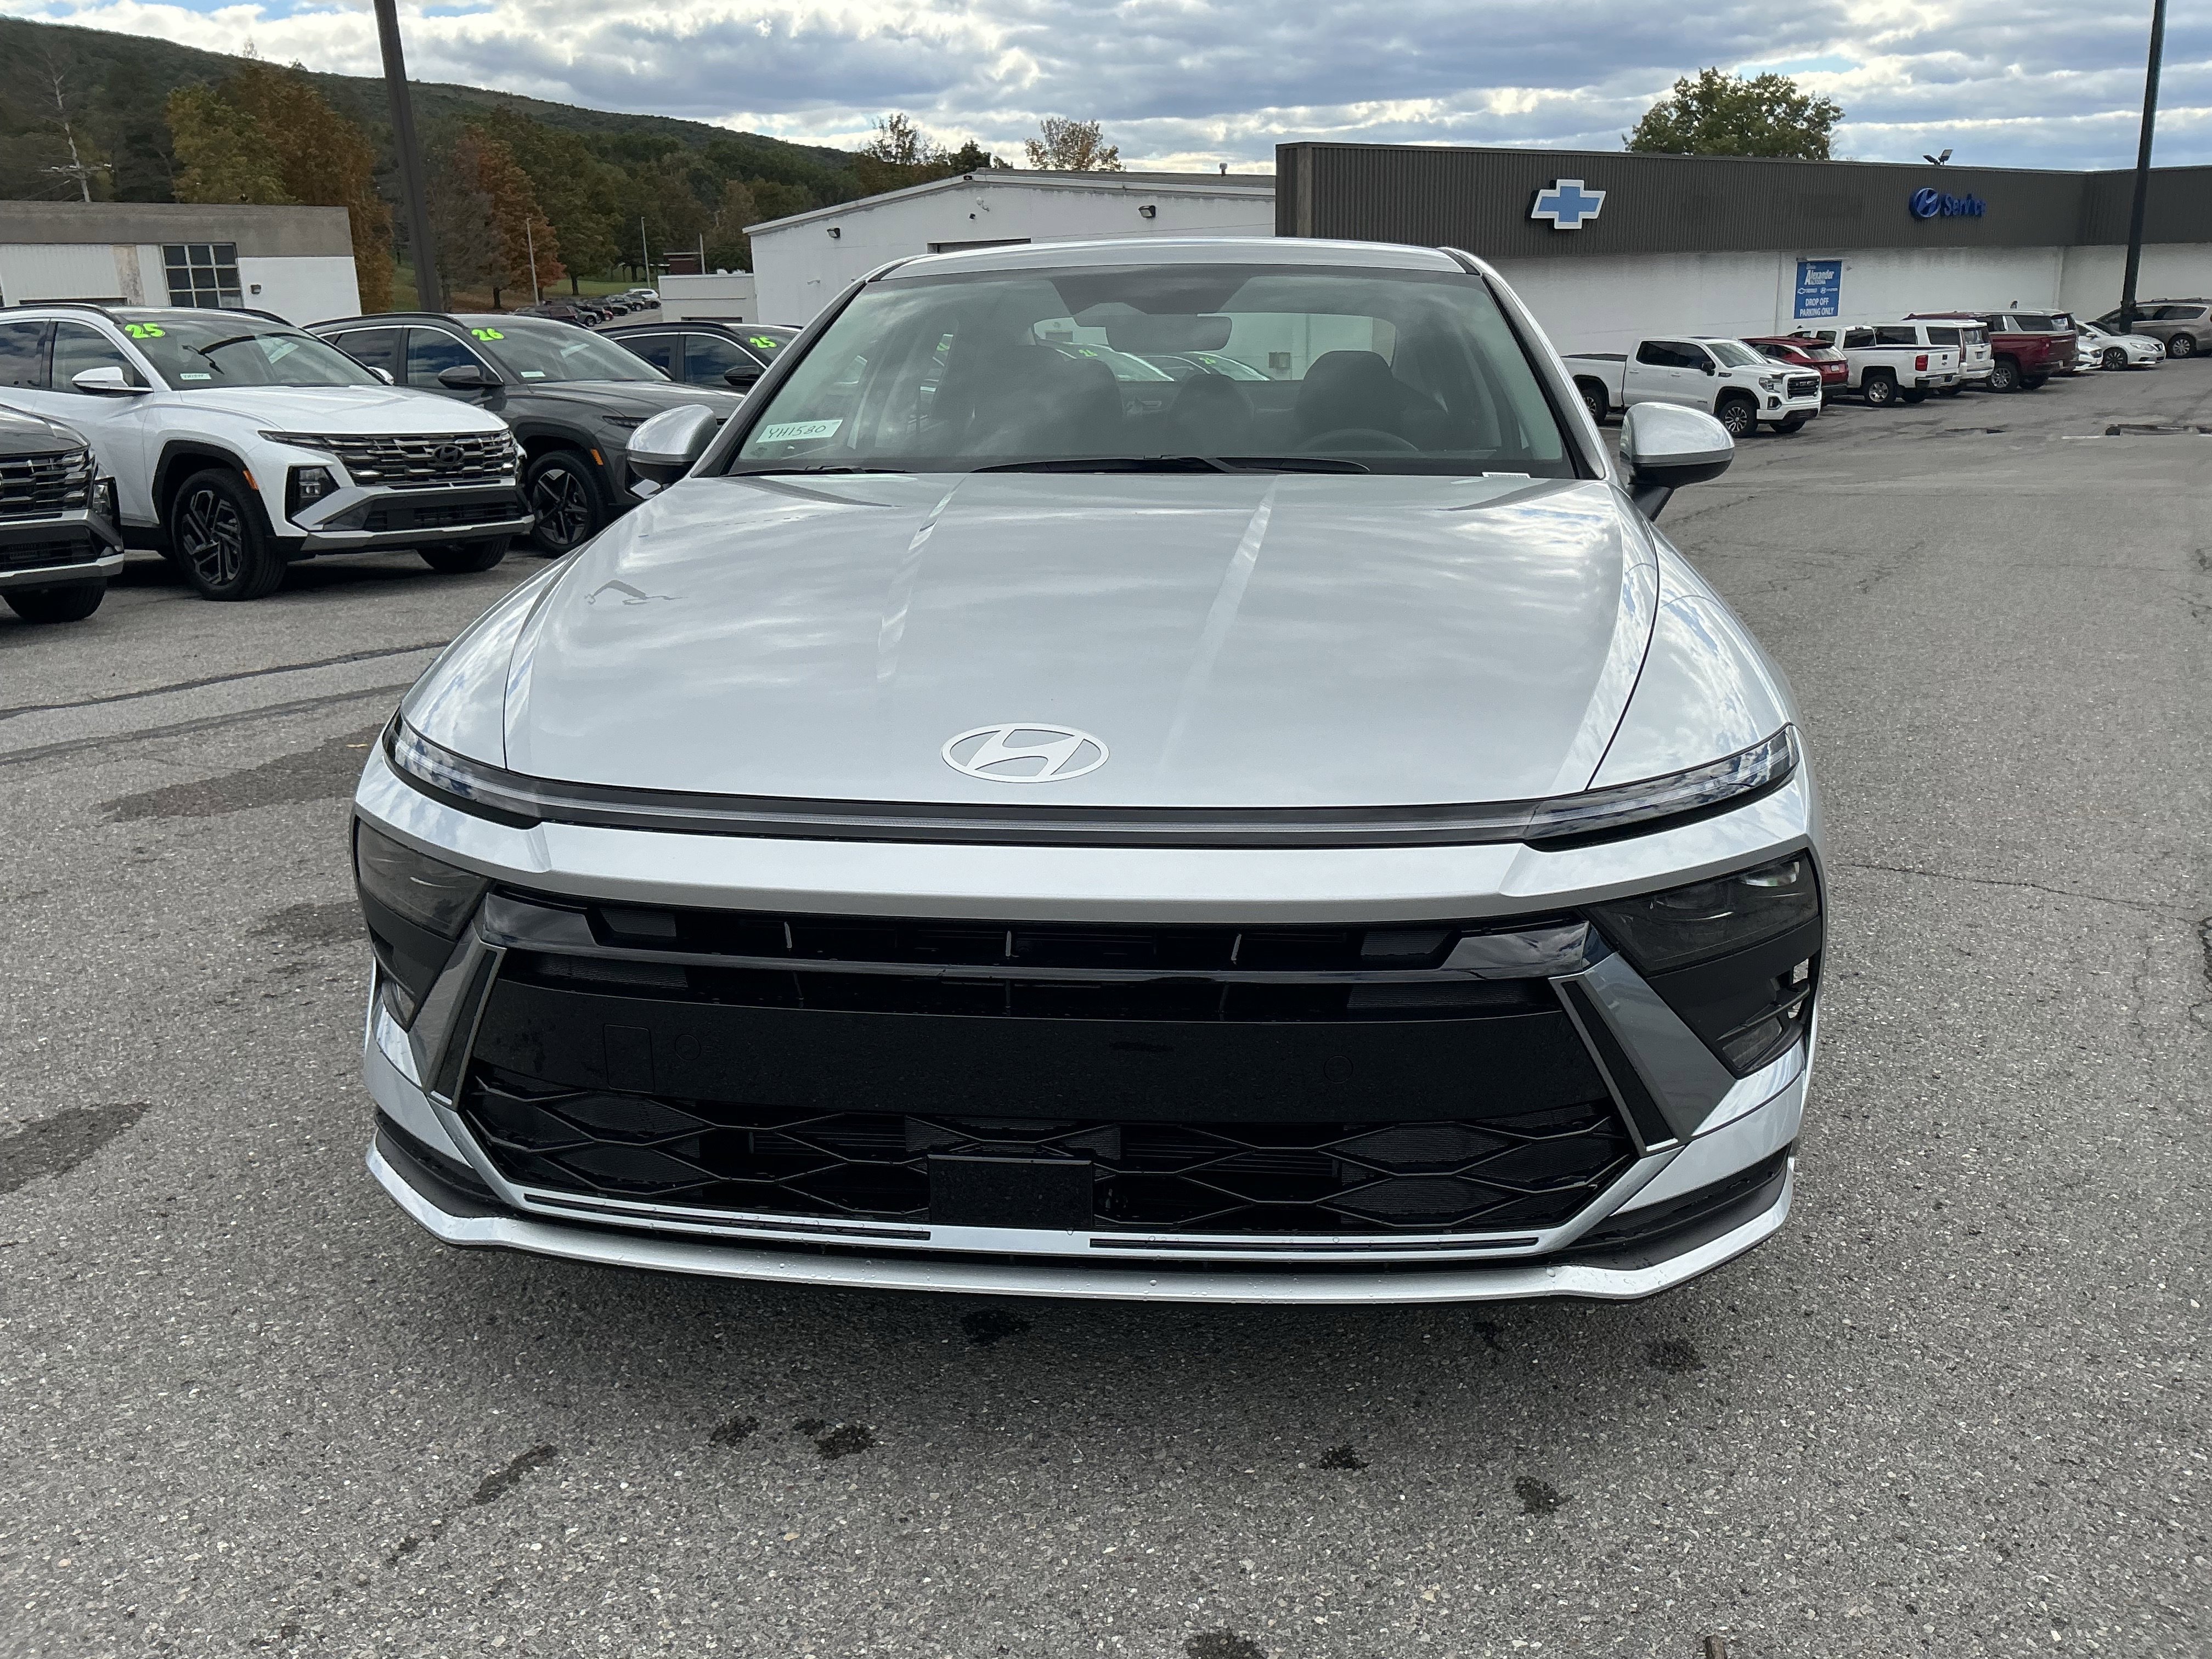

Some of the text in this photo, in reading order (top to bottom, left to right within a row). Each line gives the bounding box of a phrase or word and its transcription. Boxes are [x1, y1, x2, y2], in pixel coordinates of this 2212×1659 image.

[1805, 297, 1829, 307] DROP OFF
[1799, 307, 1835, 317] PARKING ONLY
[125, 323, 166, 338] 25
[471, 328, 505, 341] 26
[749, 336, 777, 349] 25
[769, 426, 826, 438] YH1580
